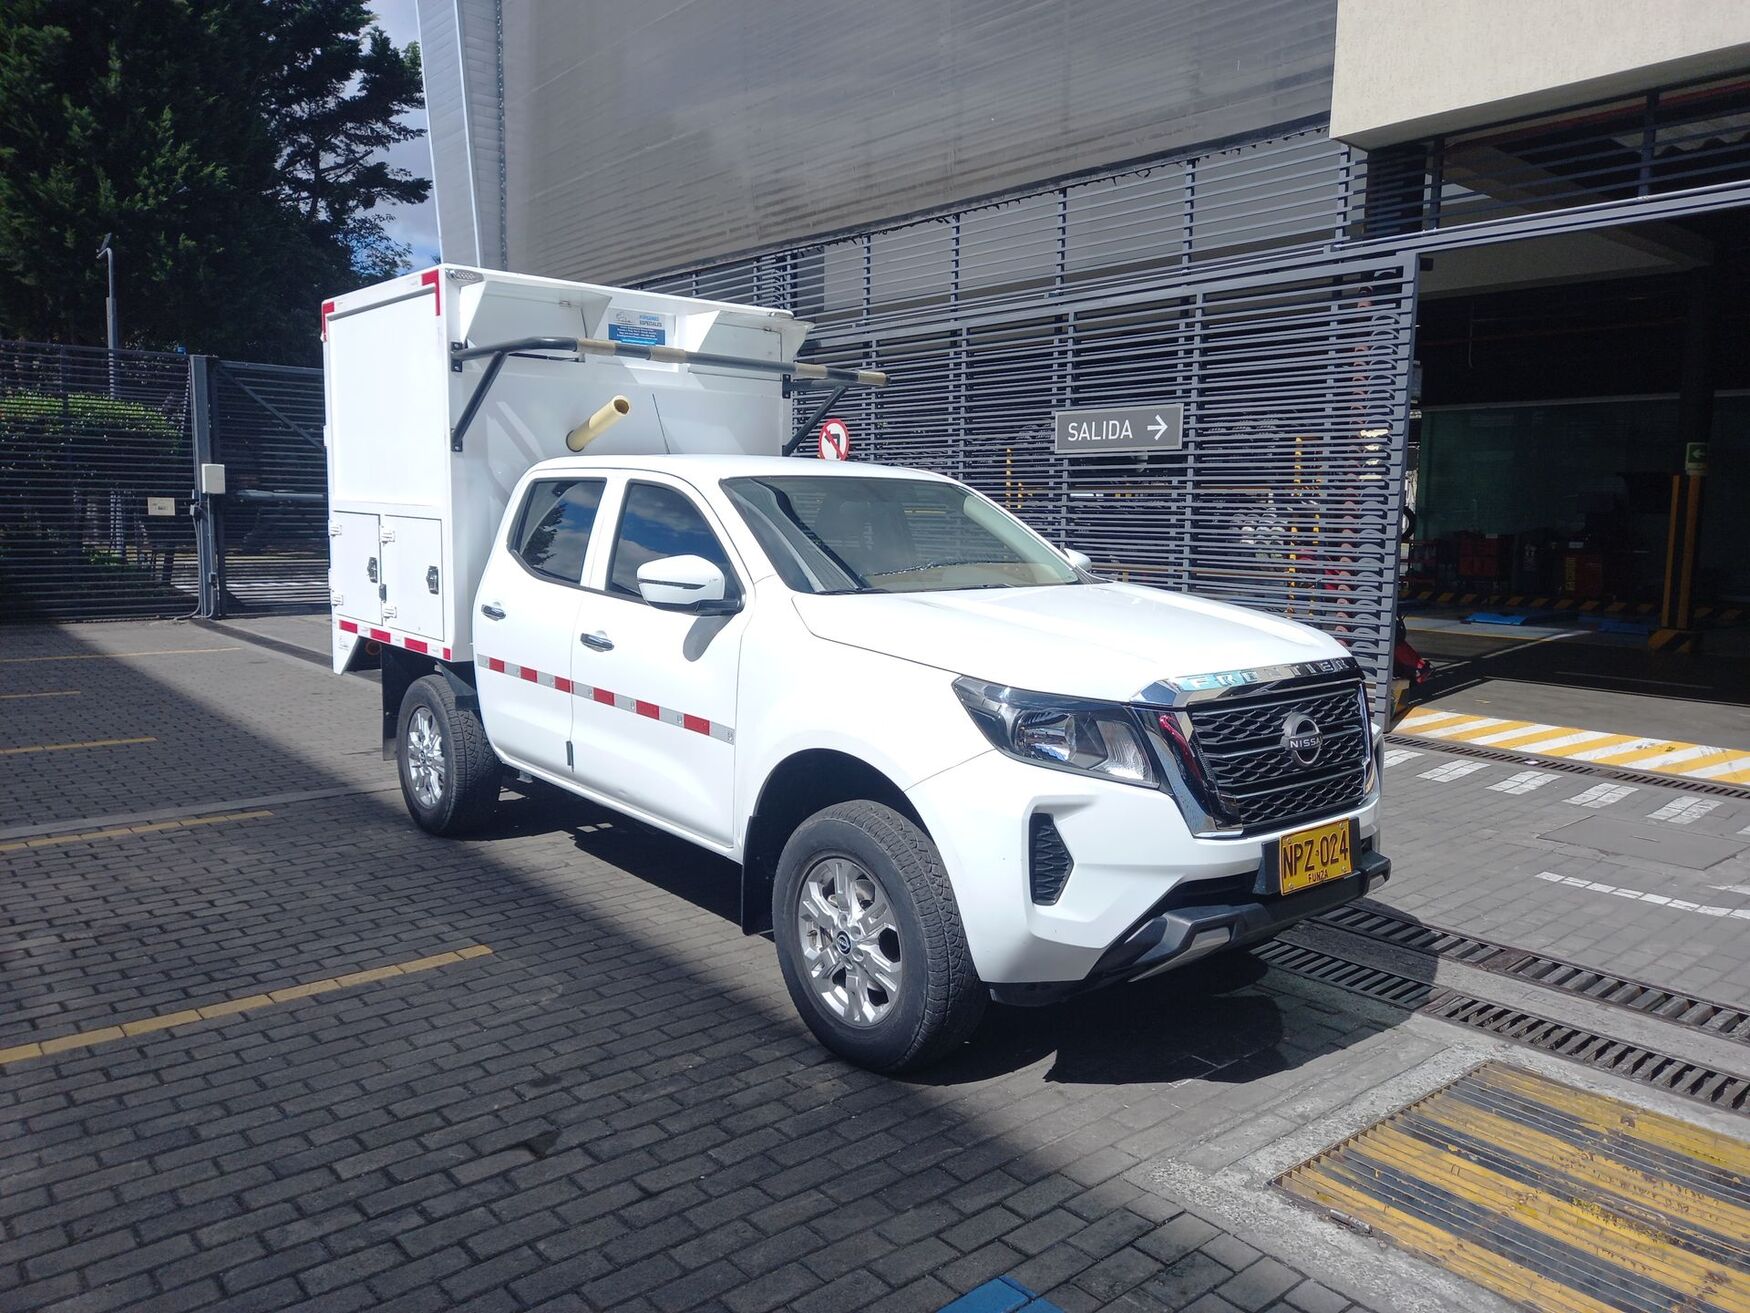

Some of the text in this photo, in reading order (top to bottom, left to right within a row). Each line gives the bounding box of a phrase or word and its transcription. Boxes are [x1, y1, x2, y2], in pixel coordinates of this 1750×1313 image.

[1067, 419, 1133, 441] SALIDA
[1189, 657, 1350, 690] FRONTIER
[1308, 869, 1329, 883] FUNZA
